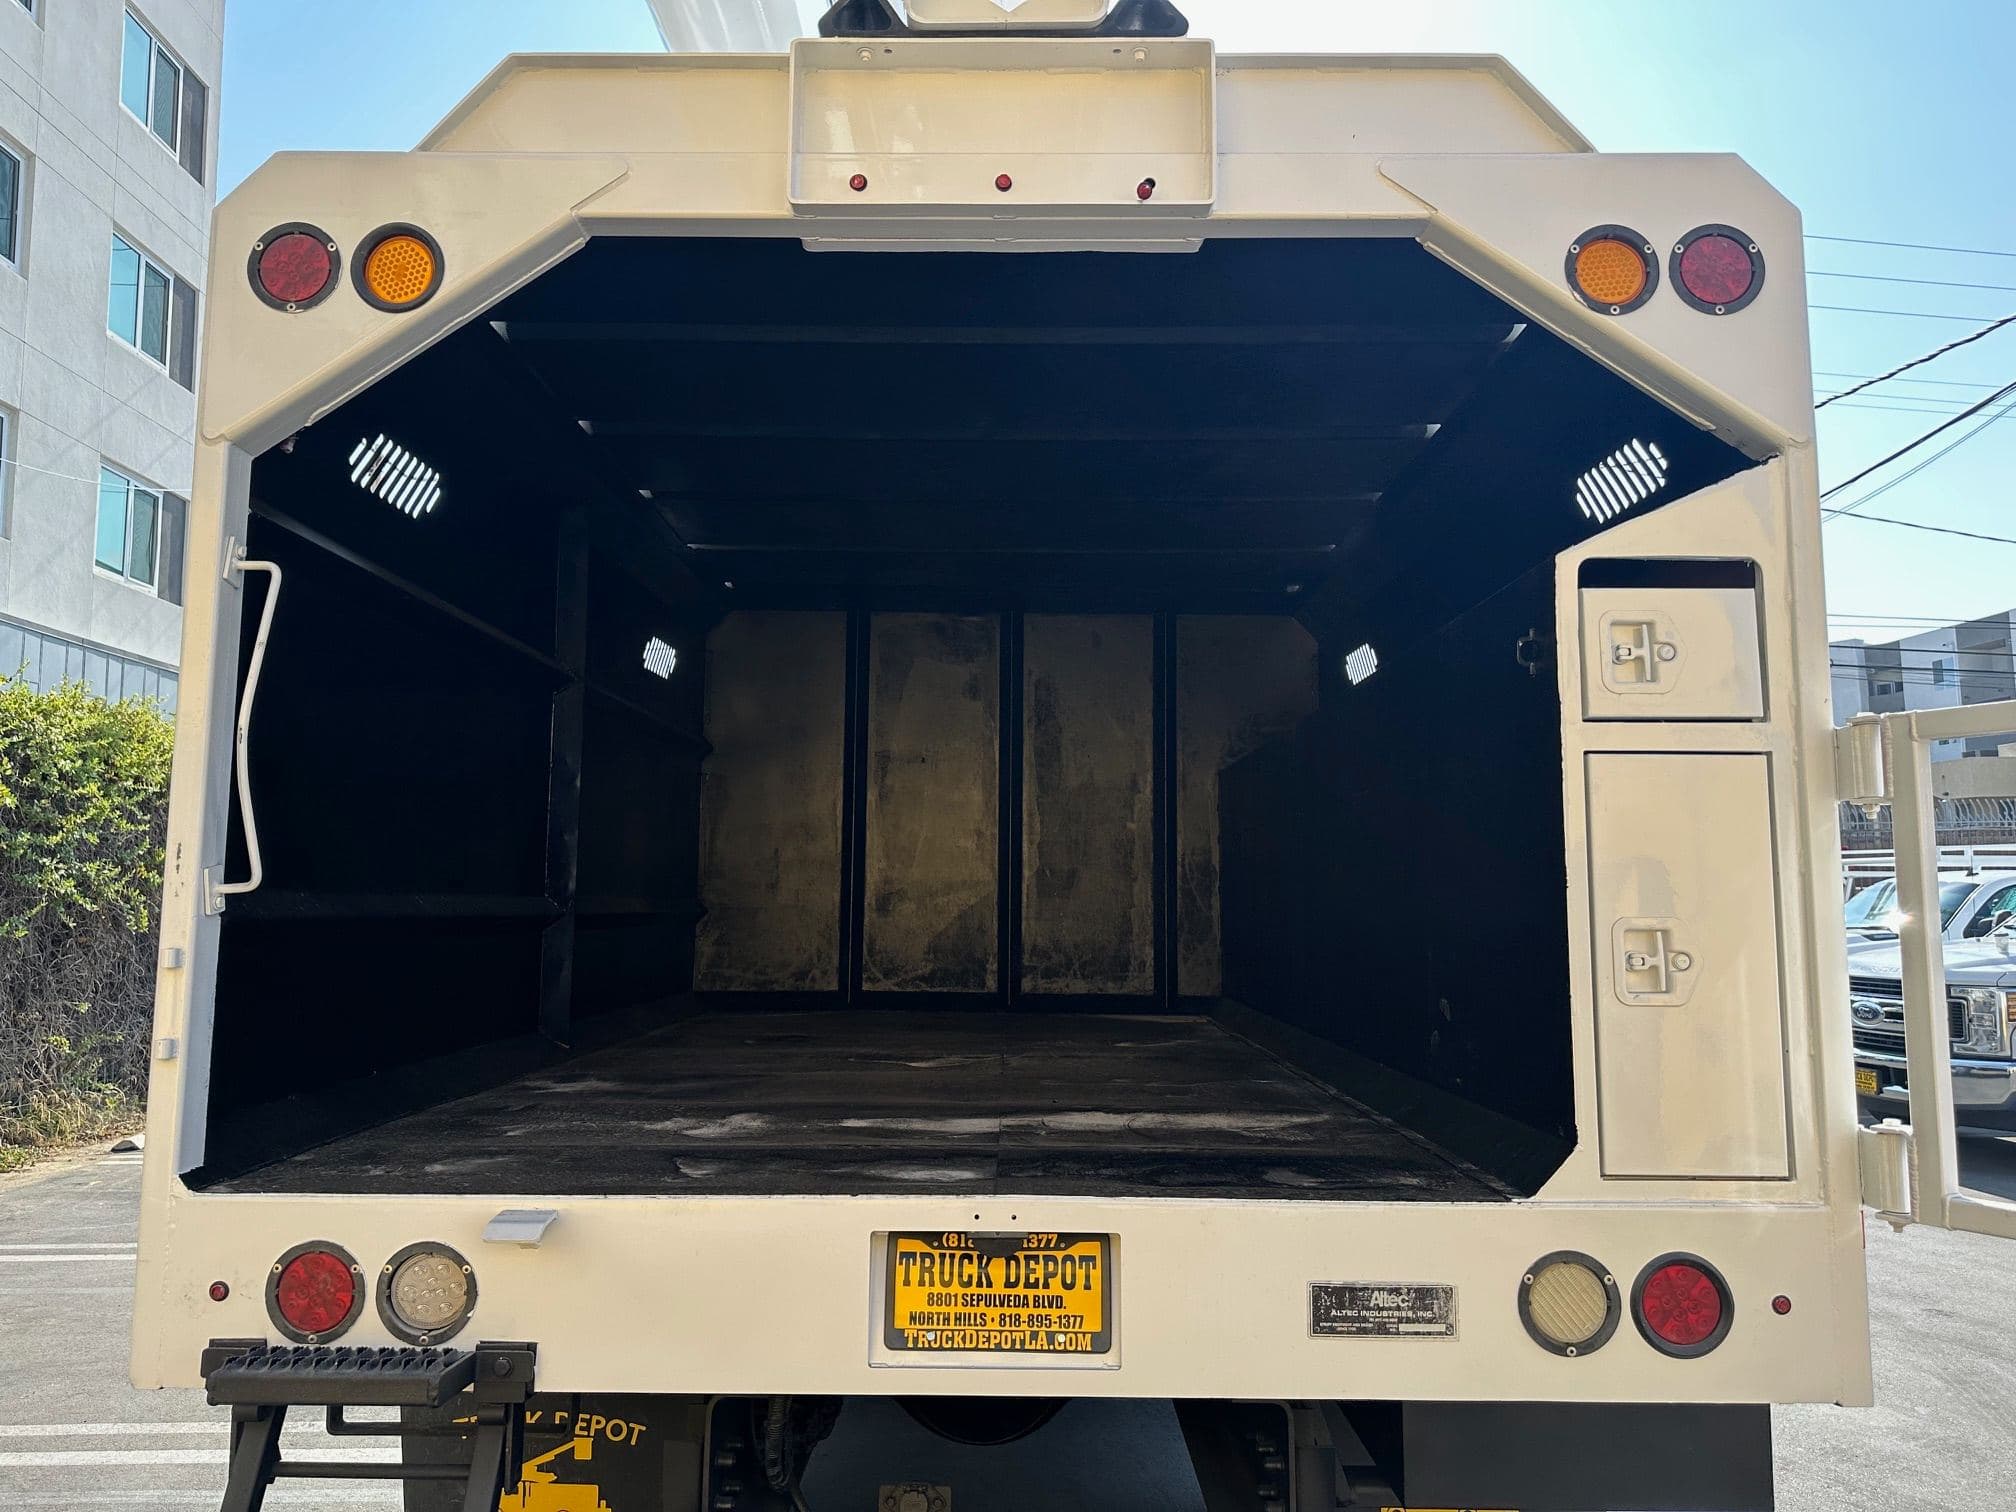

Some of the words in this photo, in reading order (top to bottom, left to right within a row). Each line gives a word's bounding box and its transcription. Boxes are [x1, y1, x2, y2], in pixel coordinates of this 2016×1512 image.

[1856, 1006, 1873, 1019] Ford
[898, 1251, 994, 1289] TRUCK
[1003, 1253, 1097, 1291] DEPOT
[926, 1292, 958, 1308] 8801
[961, 1293, 1030, 1309] SEPULVEDA
[1032, 1295, 1067, 1310] BLVD.
[909, 1310, 951, 1326] NORTH
[953, 1311, 987, 1327] HILLS
[998, 1312, 1084, 1330] 818-895-1377
[1330, 1309, 1359, 1318] ALTEC
[1360, 1310, 1416, 1319] INDUSTRIES,
